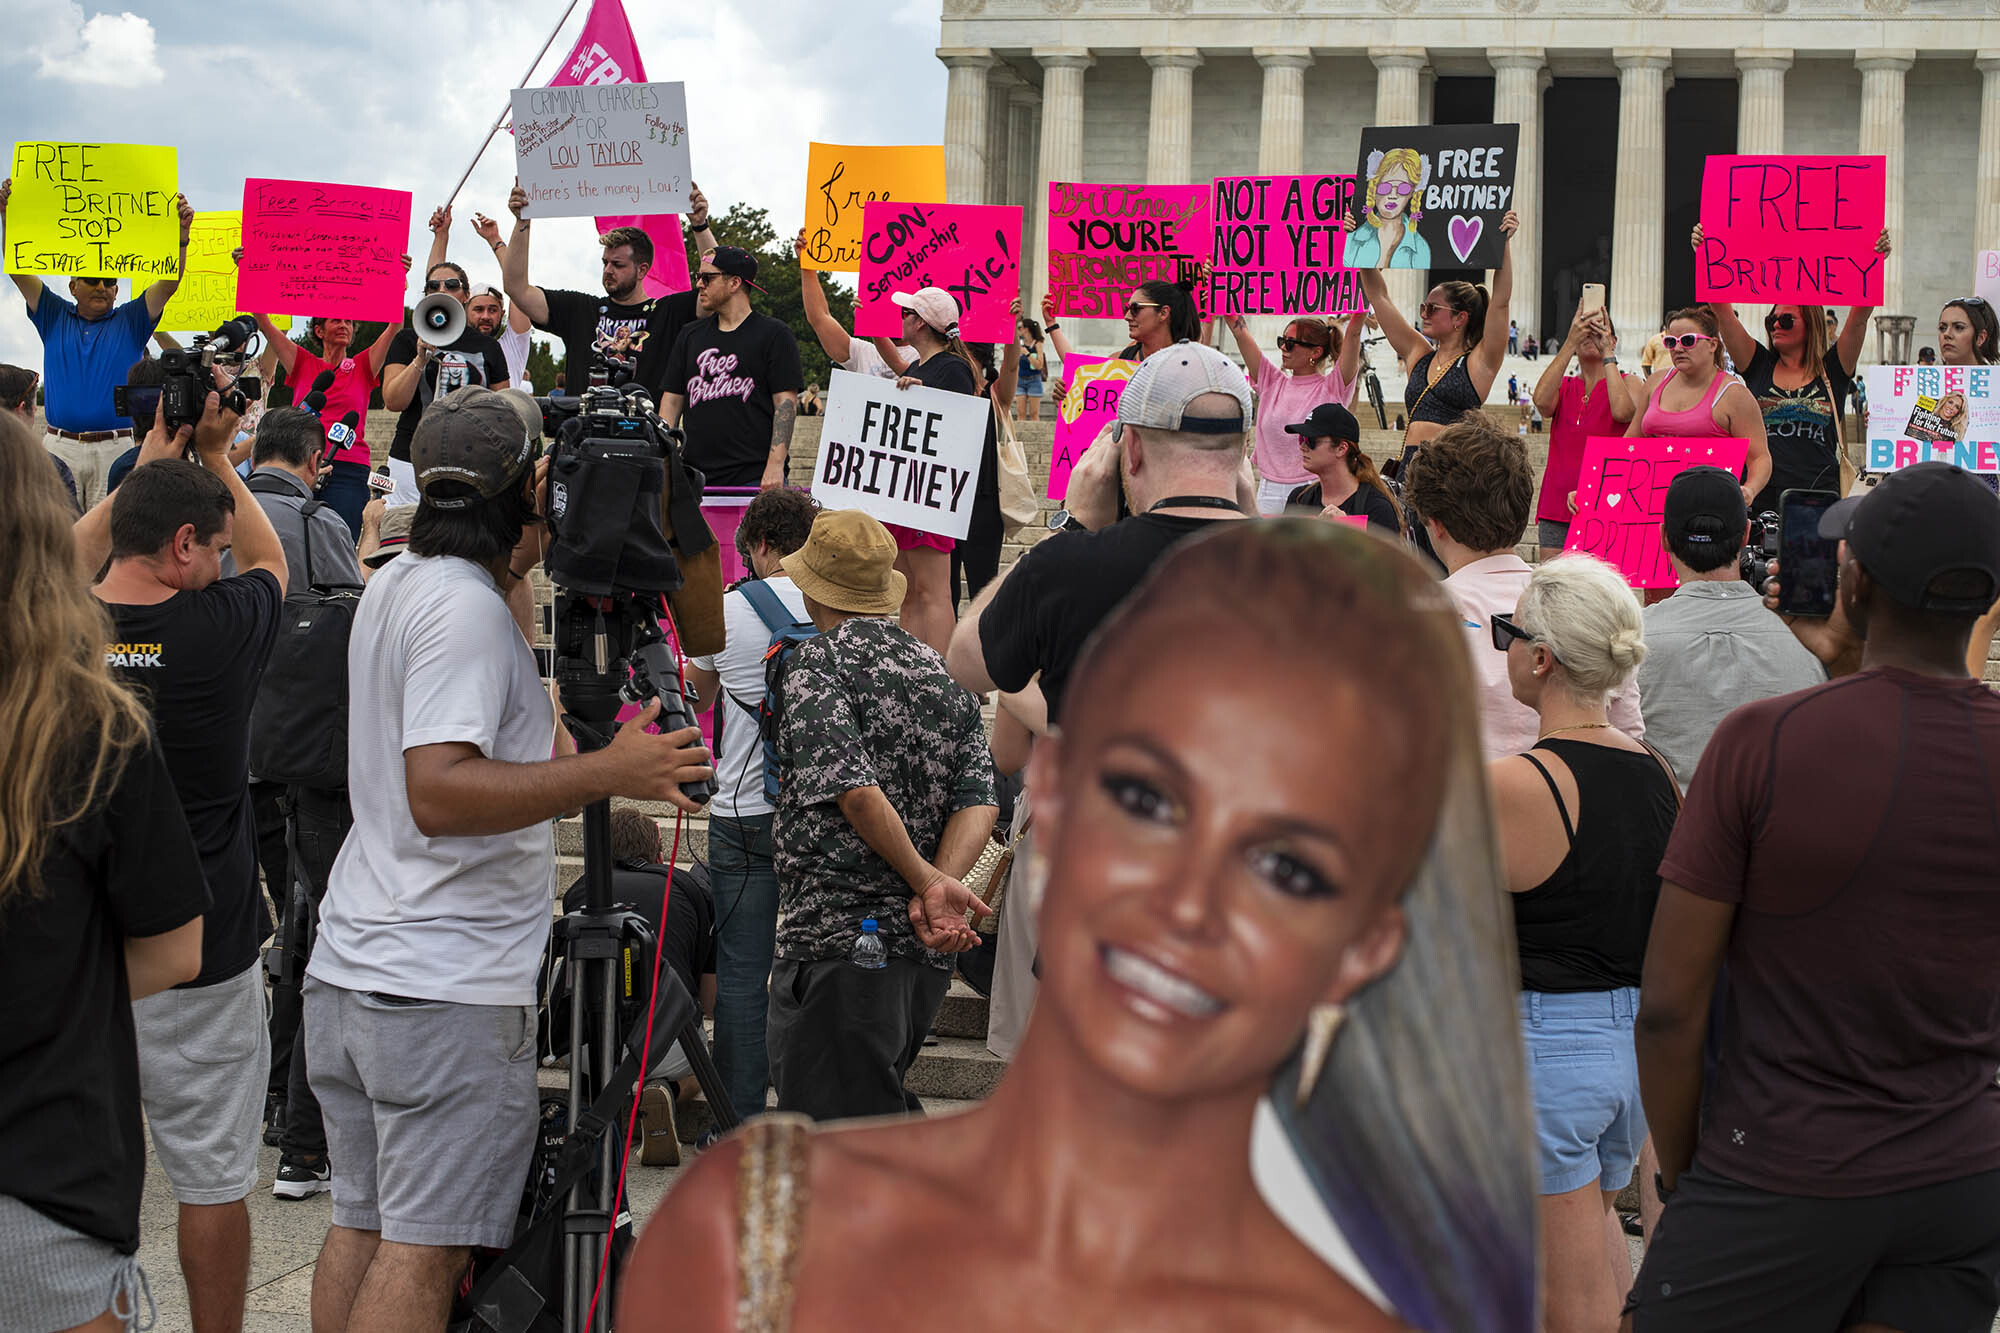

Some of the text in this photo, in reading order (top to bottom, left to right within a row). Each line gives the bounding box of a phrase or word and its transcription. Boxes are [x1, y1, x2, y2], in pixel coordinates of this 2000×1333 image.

[531, 86, 659, 116] CRIMINAL CHARGES
[519, 120, 541, 136] Shut
[519, 131, 538, 147] down
[576, 117, 607, 140] FOR
[645, 113, 685, 135] Follow the
[648, 127, 679, 147] $ $ $
[16, 144, 103, 183] FREE
[518, 141, 541, 157] Sports
[549, 140, 643, 166] LOU TAYLOR
[1437, 147, 1504, 179] FREE
[54, 184, 179, 218] BRITNEY
[523, 180, 571, 202] Where's
[577, 179, 600, 198] the
[648, 175, 681, 194] Lou?
[1215, 179, 1273, 222] NOT
[1281, 179, 1305, 222] A
[1425, 184, 1511, 211] BRITNEY
[1728, 164, 1872, 232] FREE
[1050, 183, 1209, 234] Britney
[58, 217, 122, 239] STOP
[867, 205, 935, 264] CON-
[1068, 219, 1178, 252] YOU'RE
[14, 241, 88, 273] ESTATE
[1213, 224, 1340, 268] NOT YET
[917, 272, 933, 289] is
[1049, 250, 1171, 287] STRONGER
[1703, 237, 1878, 298] BRITNEY
[1986, 252, 2000, 279] B
[1210, 270, 1370, 314] FREE WOMAN
[696, 348, 739, 378] Free
[686, 371, 756, 409] Britney
[1894, 367, 1990, 398] FREE
[860, 400, 943, 457] FREE
[1913, 406, 1941, 426] Fighting
[1913, 416, 1925, 427] for
[1924, 419, 1937, 431] Her
[1936, 424, 1959, 440] Future
[822, 441, 970, 513] BRITNEY
[104, 643, 162, 654] SOUTH
